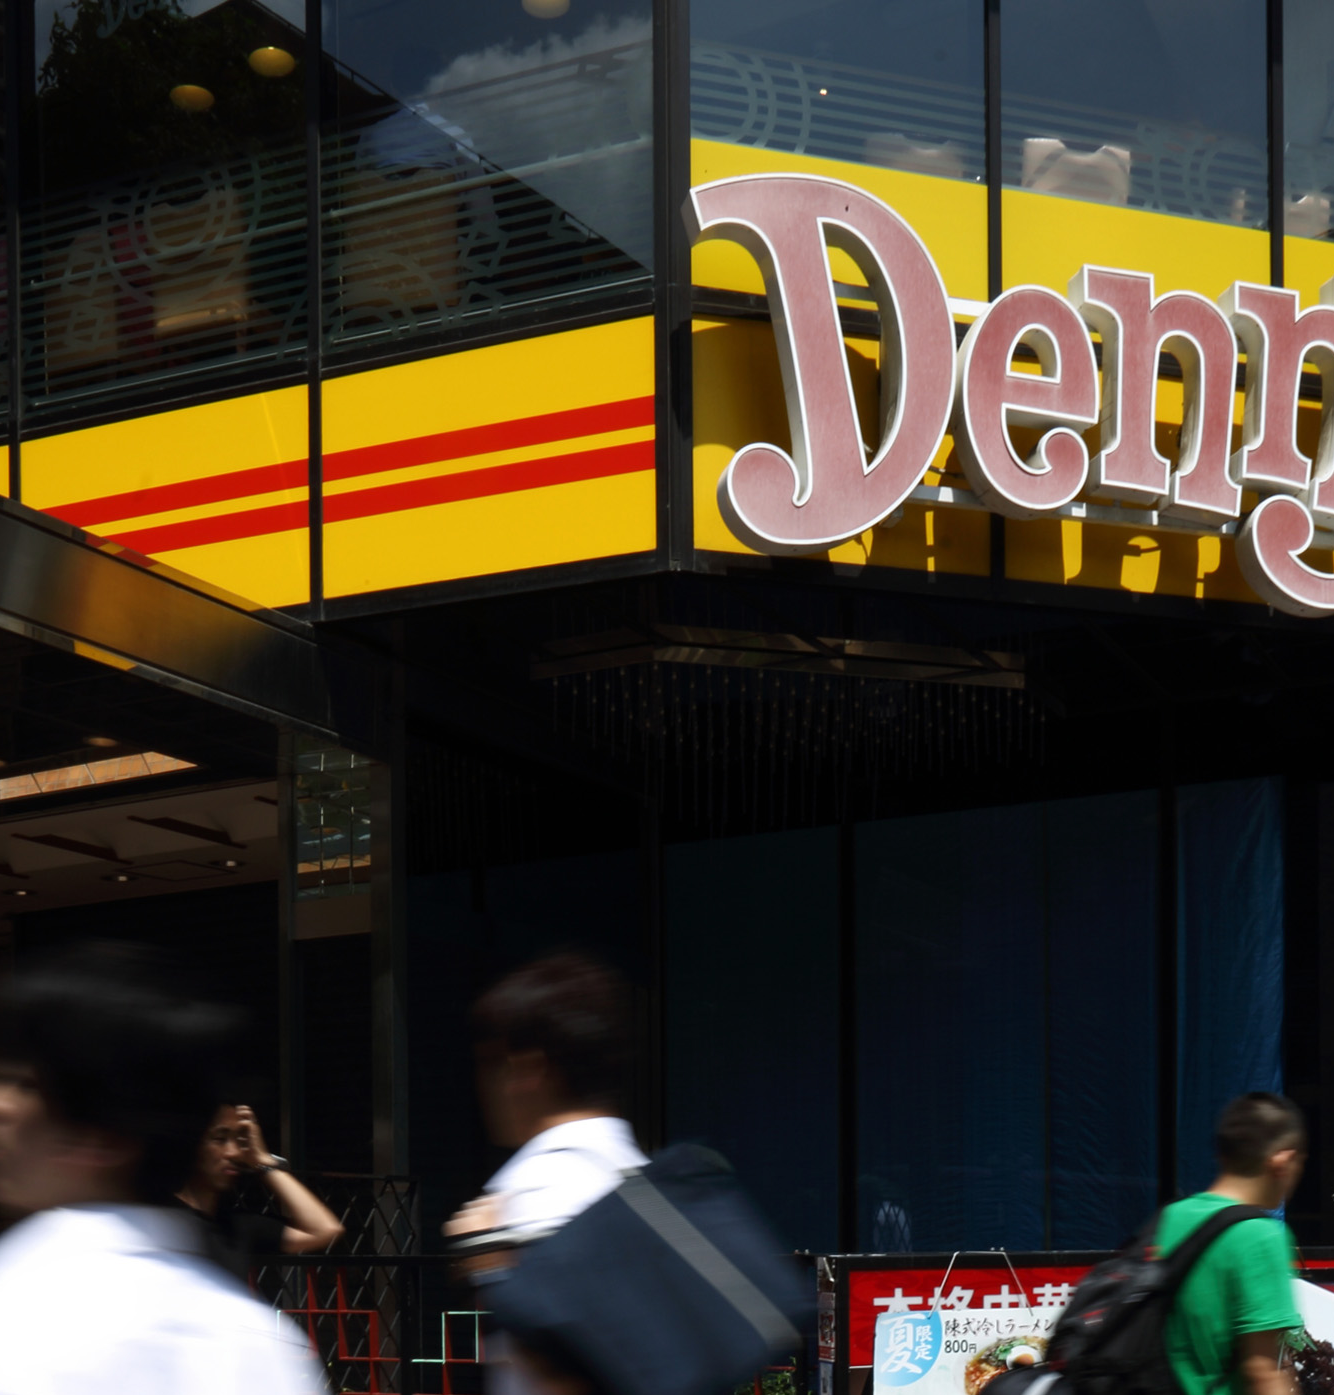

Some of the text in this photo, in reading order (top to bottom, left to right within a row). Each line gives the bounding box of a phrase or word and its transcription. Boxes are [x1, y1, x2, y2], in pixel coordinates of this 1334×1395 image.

[880, 1313, 927, 1375] 夏
[914, 1325, 934, 1361] 限定
[944, 1339, 977, 1354] 800円
